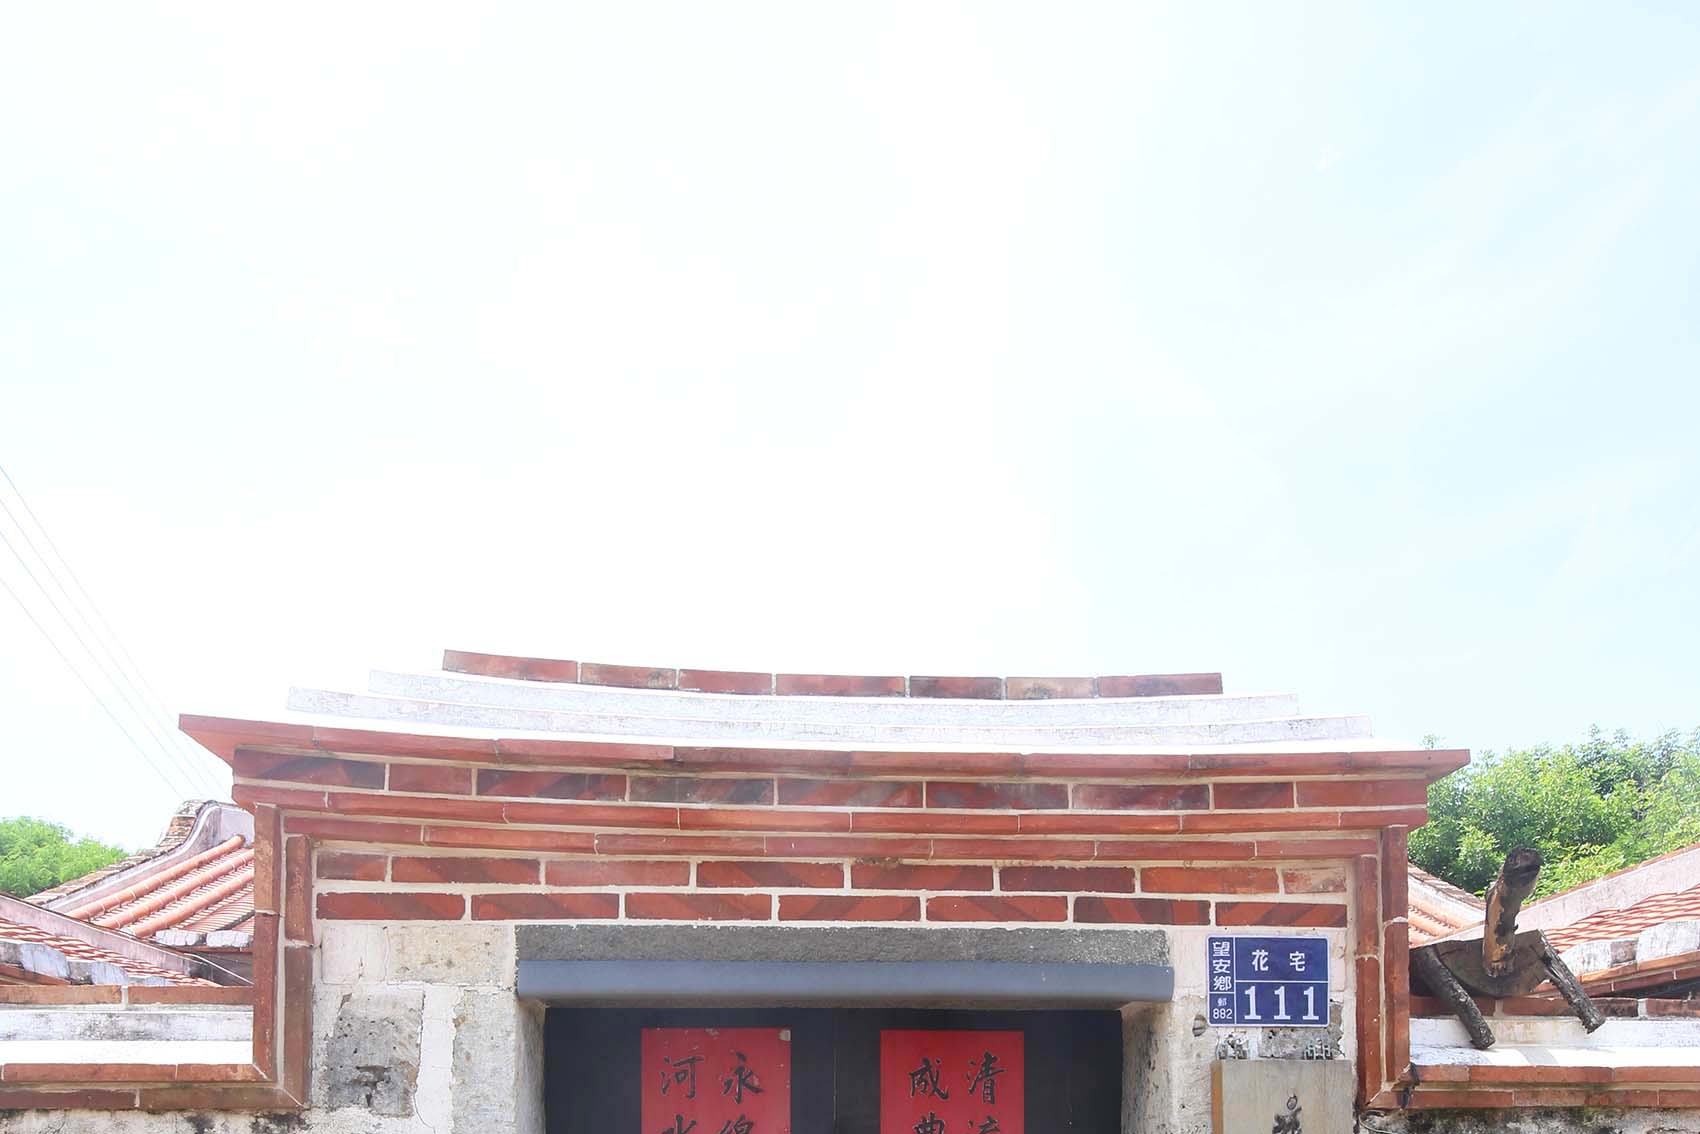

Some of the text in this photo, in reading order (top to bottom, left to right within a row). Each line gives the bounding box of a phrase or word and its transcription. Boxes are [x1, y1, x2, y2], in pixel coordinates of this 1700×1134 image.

[1212, 941, 1232, 991] 望安鄉
[1252, 949, 1306, 972] 花宅
[1213, 1008, 1233, 1020] 882
[1244, 985, 1319, 1020] 111
